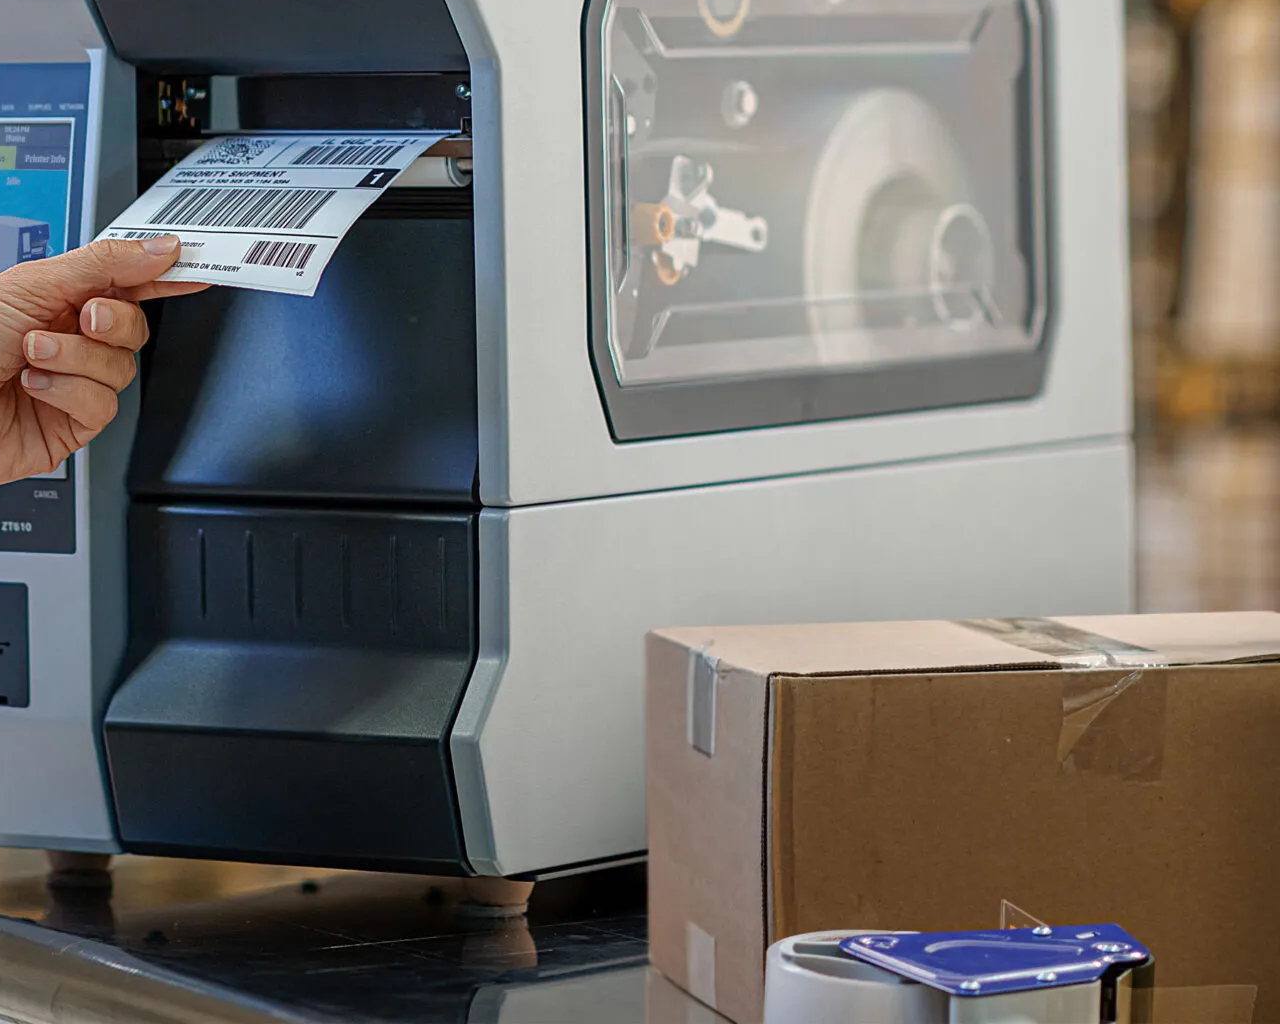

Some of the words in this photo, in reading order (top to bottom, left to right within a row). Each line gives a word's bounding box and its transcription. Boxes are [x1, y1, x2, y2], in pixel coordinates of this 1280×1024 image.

[25, 153, 50, 164] Printer
[50, 154, 66, 164] Info
[227, 170, 287, 178] SHIPMENT
[370, 172, 385, 185] 1
[173, 261, 200, 269] EQUIRED
[210, 263, 242, 273] DELIVERY
[34, 490, 59, 499] CANCEL
[1, 521, 32, 532] ZT610
